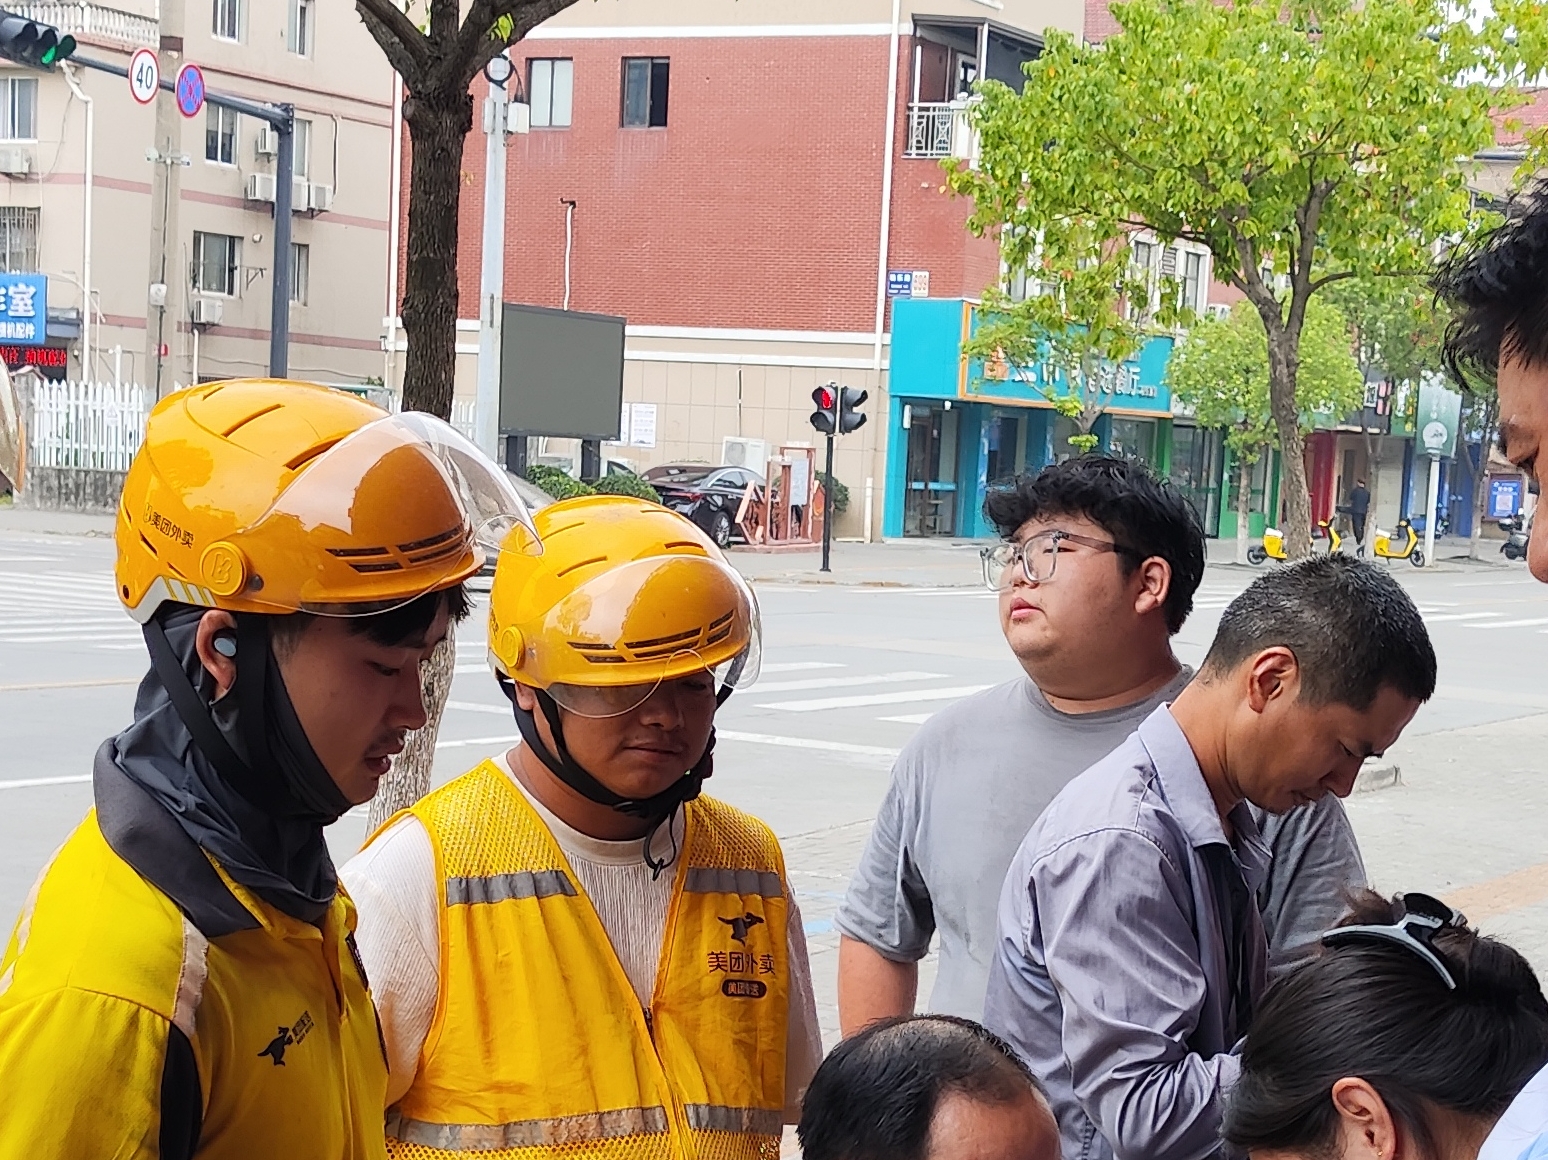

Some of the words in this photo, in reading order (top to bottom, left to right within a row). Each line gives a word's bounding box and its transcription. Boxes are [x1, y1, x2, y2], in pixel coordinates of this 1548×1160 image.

[136, 62, 153, 90] 40
[150, 511, 194, 549] 美团外卖
[707, 951, 776, 976] 美团外卖
